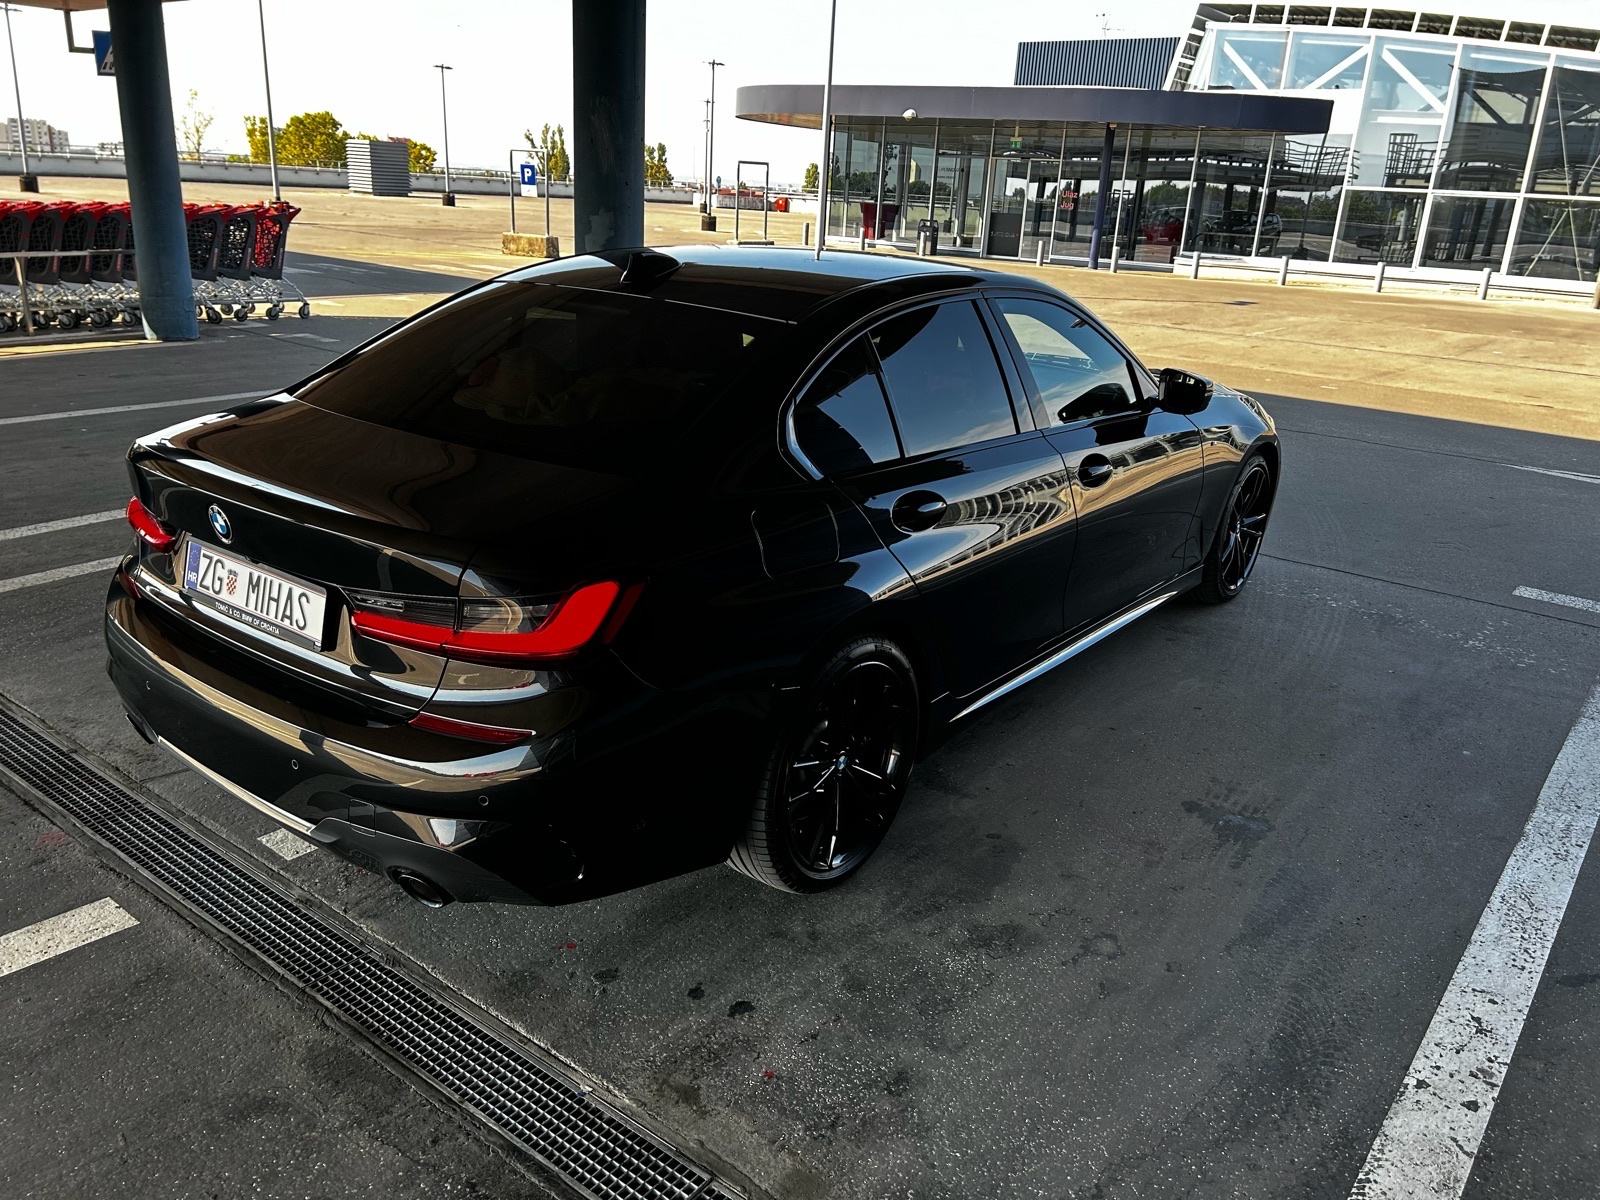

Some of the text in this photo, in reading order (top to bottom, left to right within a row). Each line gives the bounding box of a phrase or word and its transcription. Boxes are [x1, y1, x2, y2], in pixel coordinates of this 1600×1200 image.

[524, 167, 532, 182] P
[1062, 190, 1078, 199] Ulaz
[1060, 201, 1074, 210] Jug
[187, 570, 198, 584] HR
[199, 552, 311, 631] ZG MIHAS
[253, 618, 260, 626] OF
[260, 621, 280, 635] CROATIA
